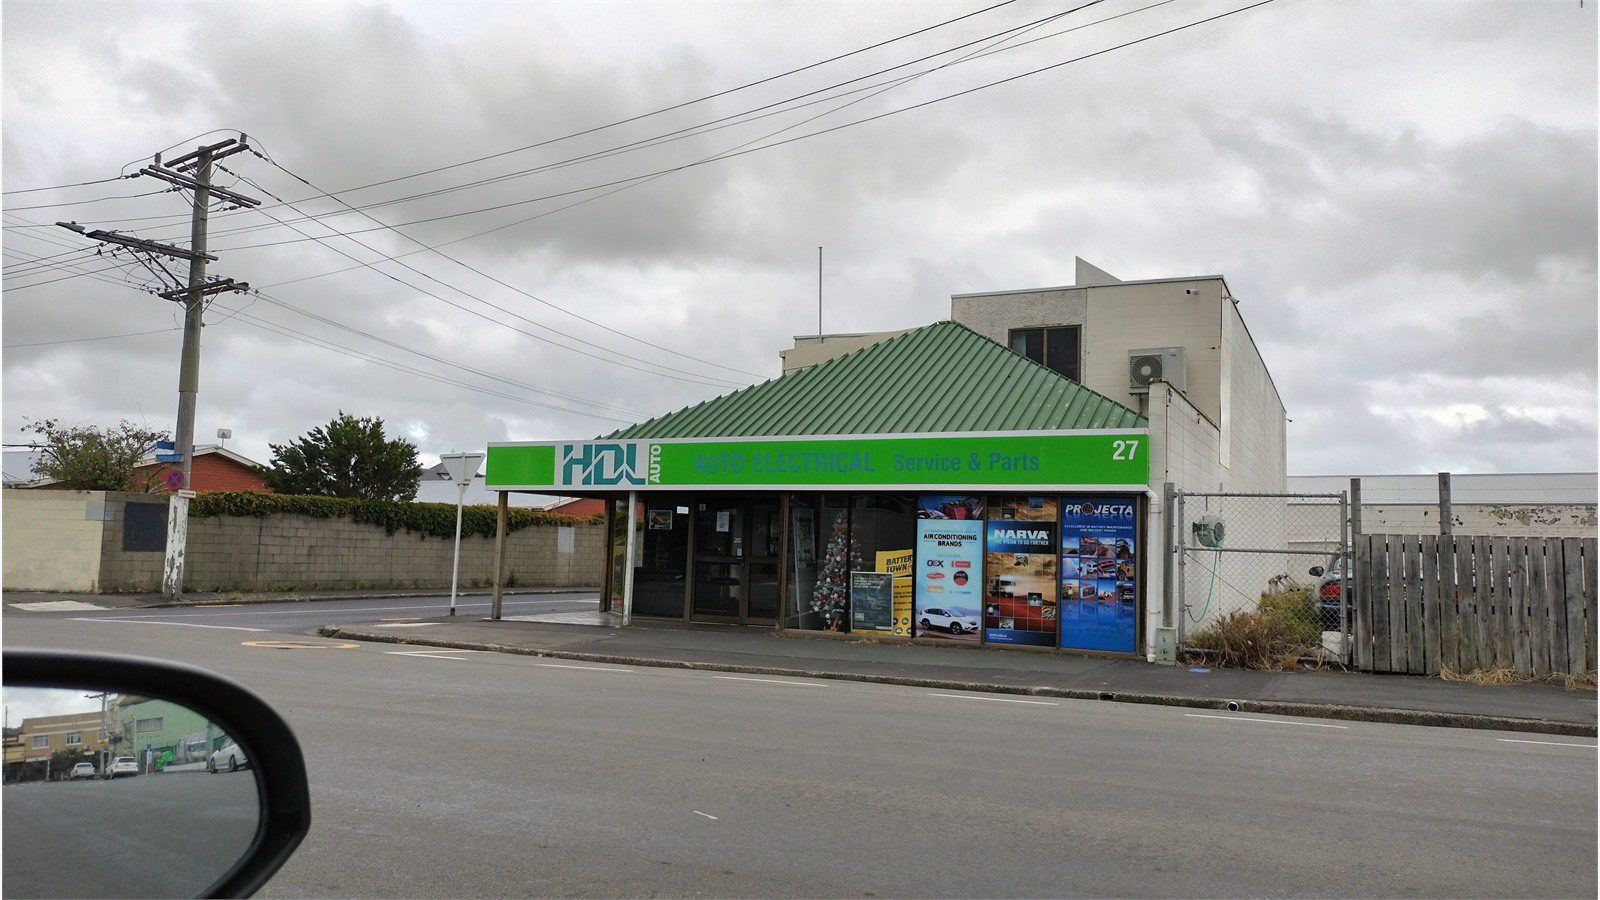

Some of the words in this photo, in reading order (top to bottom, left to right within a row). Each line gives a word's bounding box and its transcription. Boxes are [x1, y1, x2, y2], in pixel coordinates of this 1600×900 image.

[1112, 440, 1139, 460] 27
[562, 443, 646, 485] HDL
[649, 444, 662, 483] AUTO
[693, 453, 745, 473] AUTO
[753, 451, 875, 473] ELECTRICAL
[893, 453, 961, 472] Service
[967, 453, 981, 472] &
[989, 451, 1040, 472] Parts
[1065, 502, 1133, 515] PROJECTA
[934, 533, 977, 541] CONDITIONING
[994, 529, 1048, 540] NARVA
[886, 563, 907, 573] TOWN
